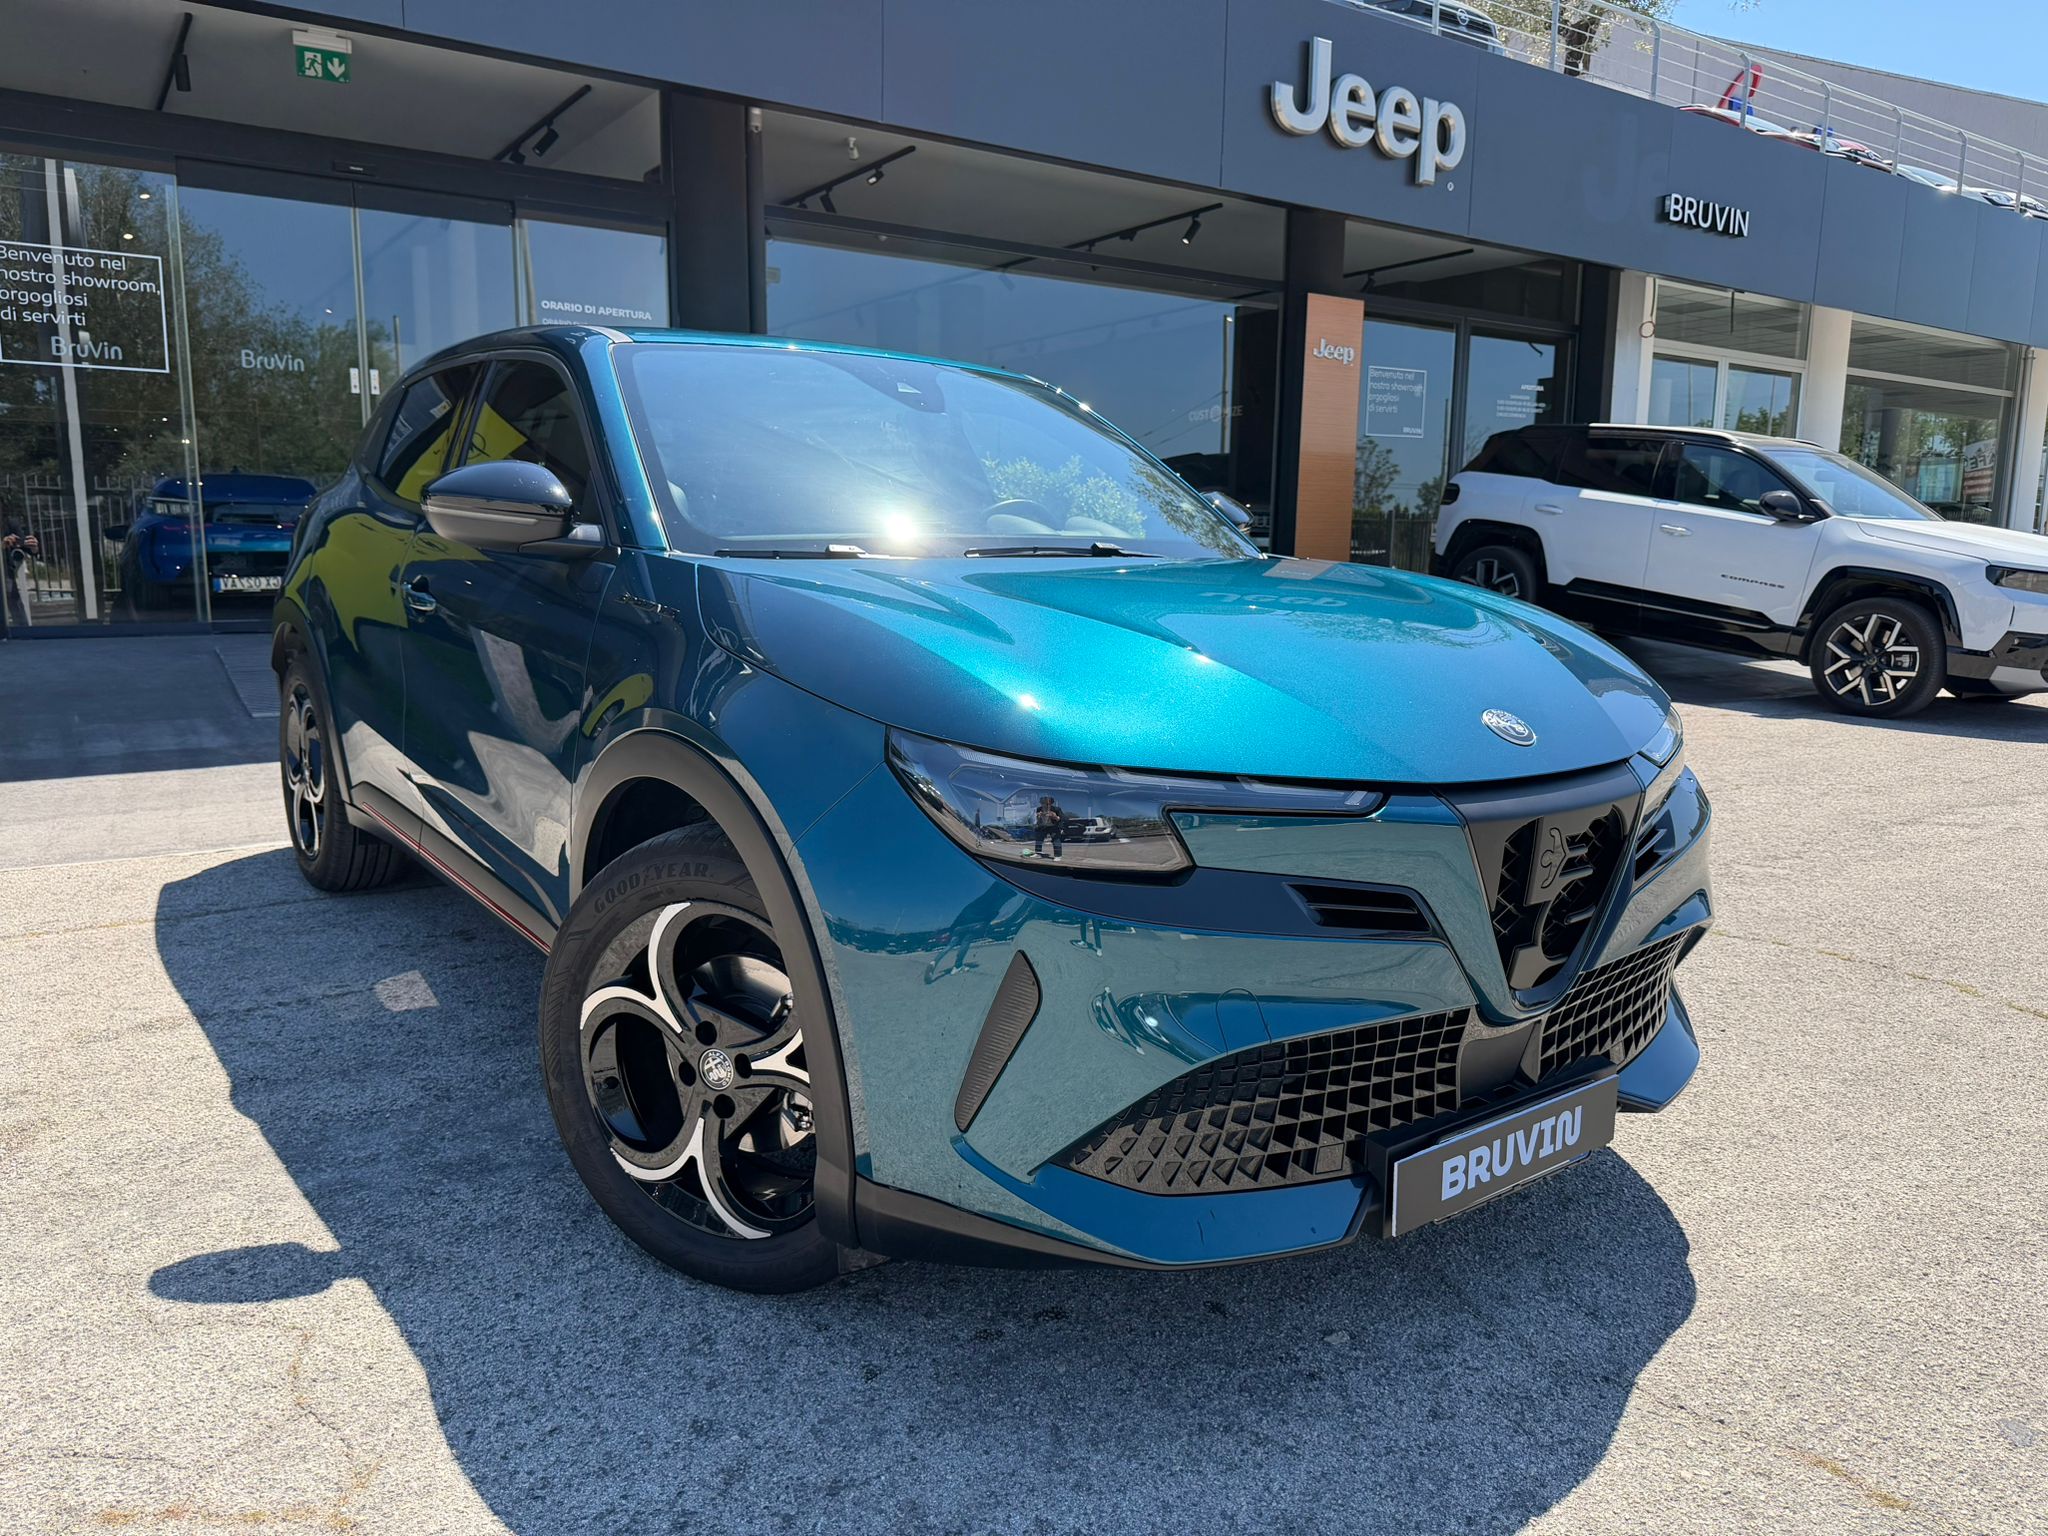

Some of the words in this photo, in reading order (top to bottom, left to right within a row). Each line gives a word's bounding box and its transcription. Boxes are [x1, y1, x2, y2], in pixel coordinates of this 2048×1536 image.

[1270, 36, 1466, 185] Jeep
[1669, 193, 1750, 237] BRUVIN
[100, 256, 126, 270] nel
[62, 271, 161, 296] showroom,
[0, 289, 88, 307] orgogliosi
[541, 300, 582, 312] ORARIO
[584, 305, 596, 315] DI
[598, 306, 652, 320] APERTURA
[1, 306, 17, 321] di
[22, 311, 86, 326] servirti
[51, 336, 123, 360] BruVin
[1313, 338, 1354, 365] Jeep
[241, 349, 305, 372] BruVin
[1441, 1105, 1583, 1201] BRUVIN
